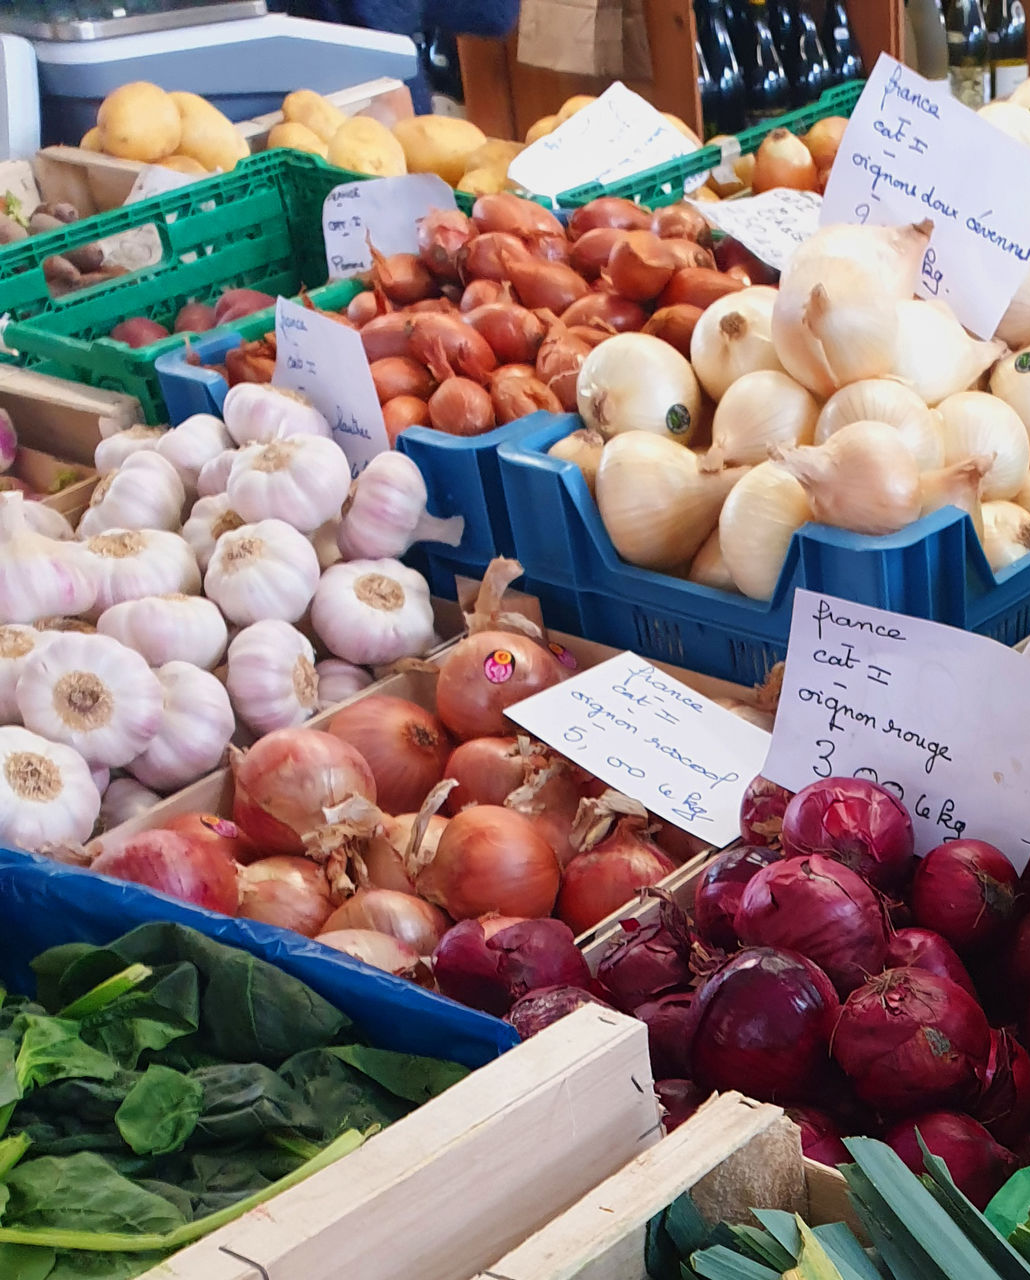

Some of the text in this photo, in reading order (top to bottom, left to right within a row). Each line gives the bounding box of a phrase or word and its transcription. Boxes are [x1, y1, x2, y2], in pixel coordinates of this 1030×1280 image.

[881, 65, 940, 119] france
[873, 117, 911, 142] cat
[852, 152, 917, 197] oignons
[920, 186, 958, 220] doux
[813, 600, 907, 640] france
[813, 643, 860, 669] cat
[611, 683, 651, 707] cat
[628, 666, 703, 713] france
[571, 690, 638, 735] oignon
[798, 687, 952, 774] oignon rouge
[936, 799, 966, 844] kg
